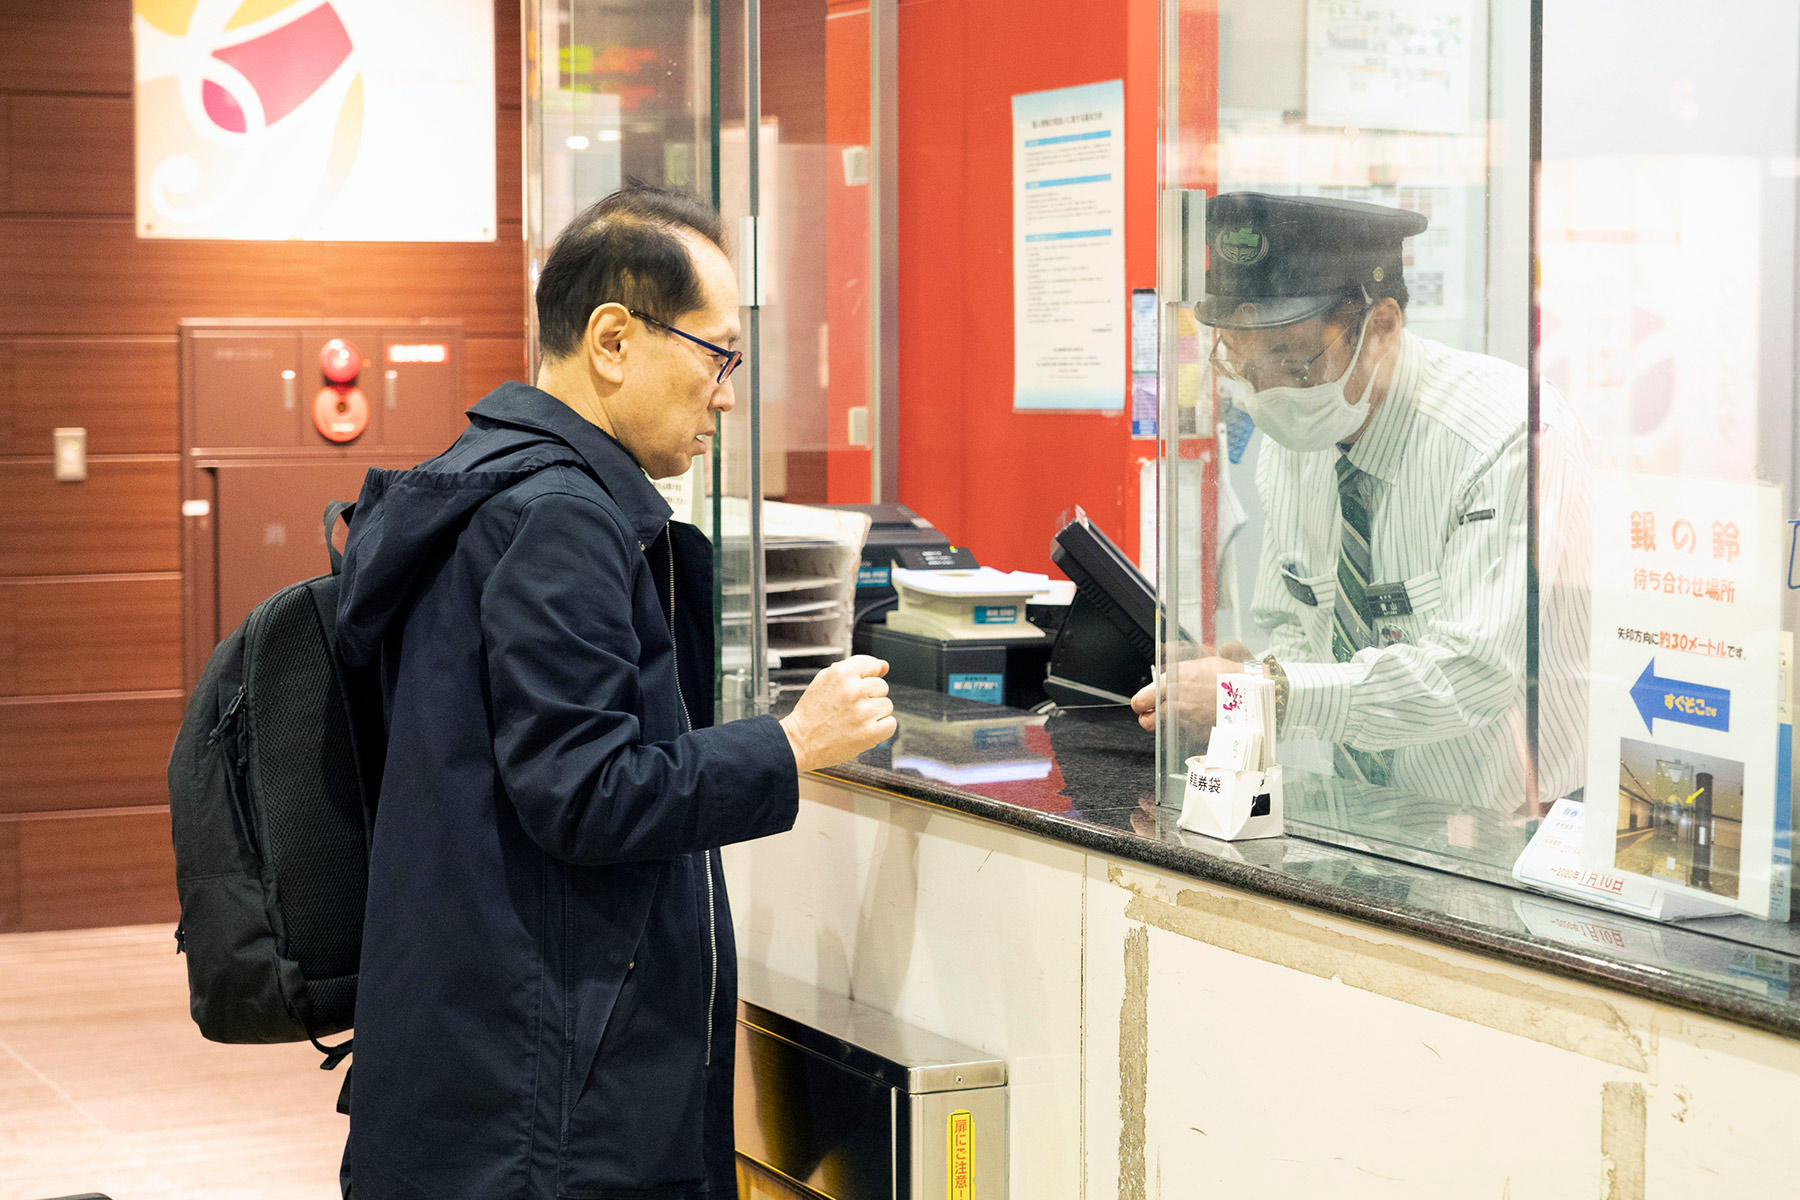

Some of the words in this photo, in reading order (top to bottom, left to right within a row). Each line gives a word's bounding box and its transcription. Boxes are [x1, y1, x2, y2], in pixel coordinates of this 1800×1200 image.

[1630, 510, 1740, 562] 銀の鈴
[1633, 568, 1735, 602] 待ち合わせ場所
[1617, 627, 1746, 660] 矢印方向に約30メートルです。
